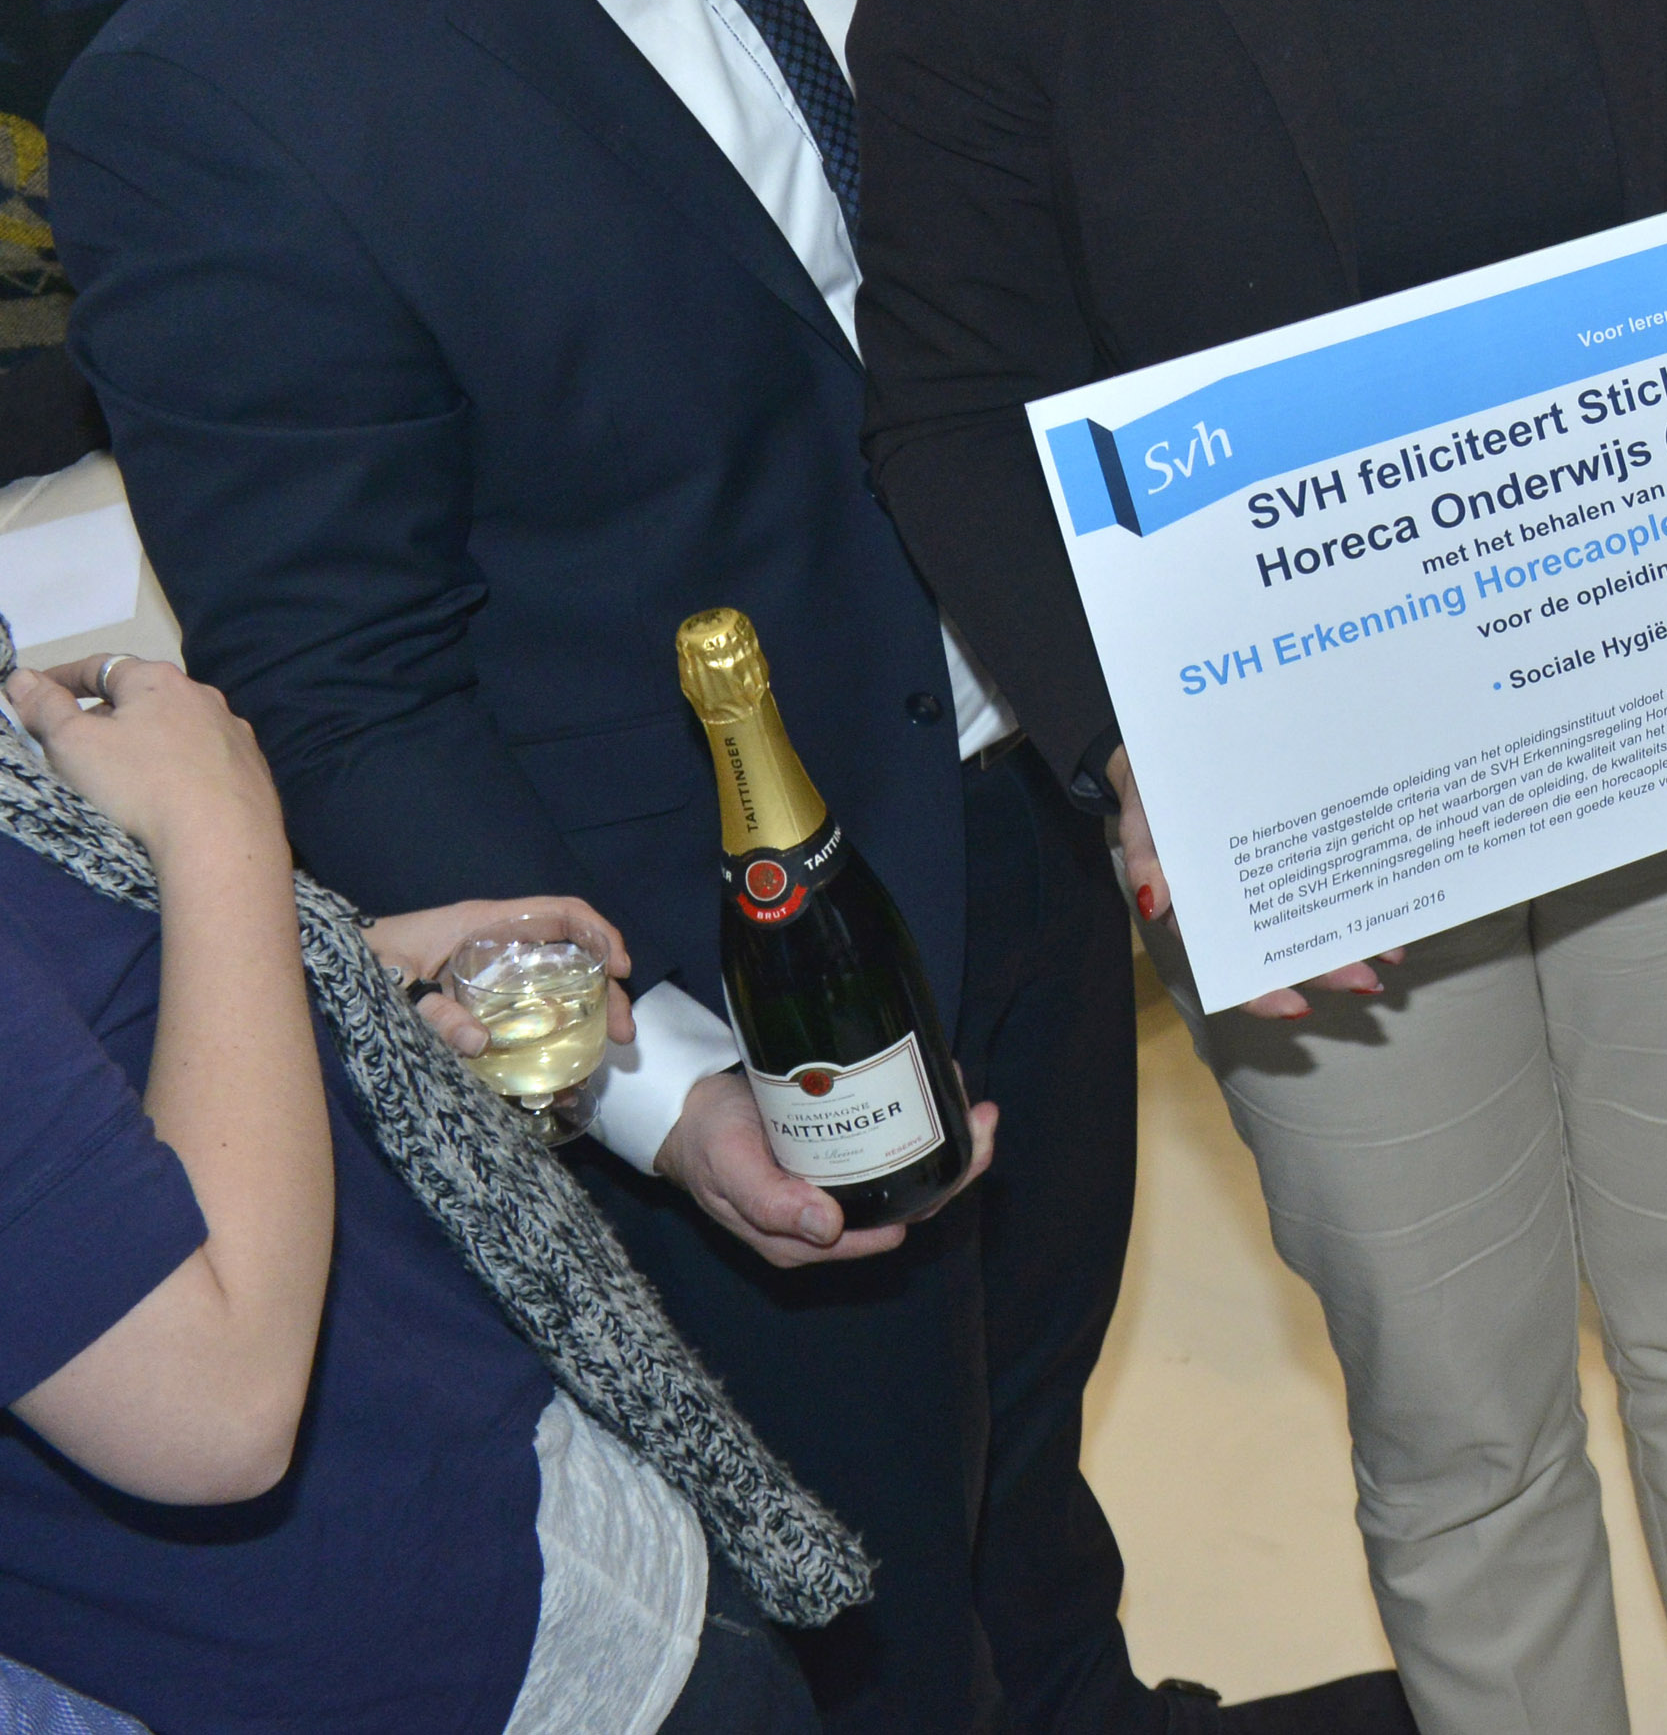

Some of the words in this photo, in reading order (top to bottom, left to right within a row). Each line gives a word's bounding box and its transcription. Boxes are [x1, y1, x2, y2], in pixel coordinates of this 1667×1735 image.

[1576, 323, 1624, 347] Voor
[1144, 420, 1233, 495] Svh
[1247, 468, 1347, 529] SVH
[1357, 401, 1568, 495] feliciteert
[1255, 515, 1420, 588] Horeca
[1430, 438, 1652, 529] Onderwijs
[1421, 543, 1469, 574] met
[1473, 528, 1515, 557] het
[1518, 500, 1615, 542] behalen
[1620, 483, 1665, 508] van
[1179, 644, 1263, 695] SVH
[1271, 584, 1466, 665] Erkenning
[1476, 607, 1532, 638] voor
[1539, 596, 1569, 617] de
[1508, 648, 1595, 689] Sociale
[724, 736, 759, 832] TAITTINGER
[757, 907, 787, 920] BRUT
[770, 1101, 902, 1138] TAITTINGER
[787, 1102, 870, 1122] CHAMPAGNE
